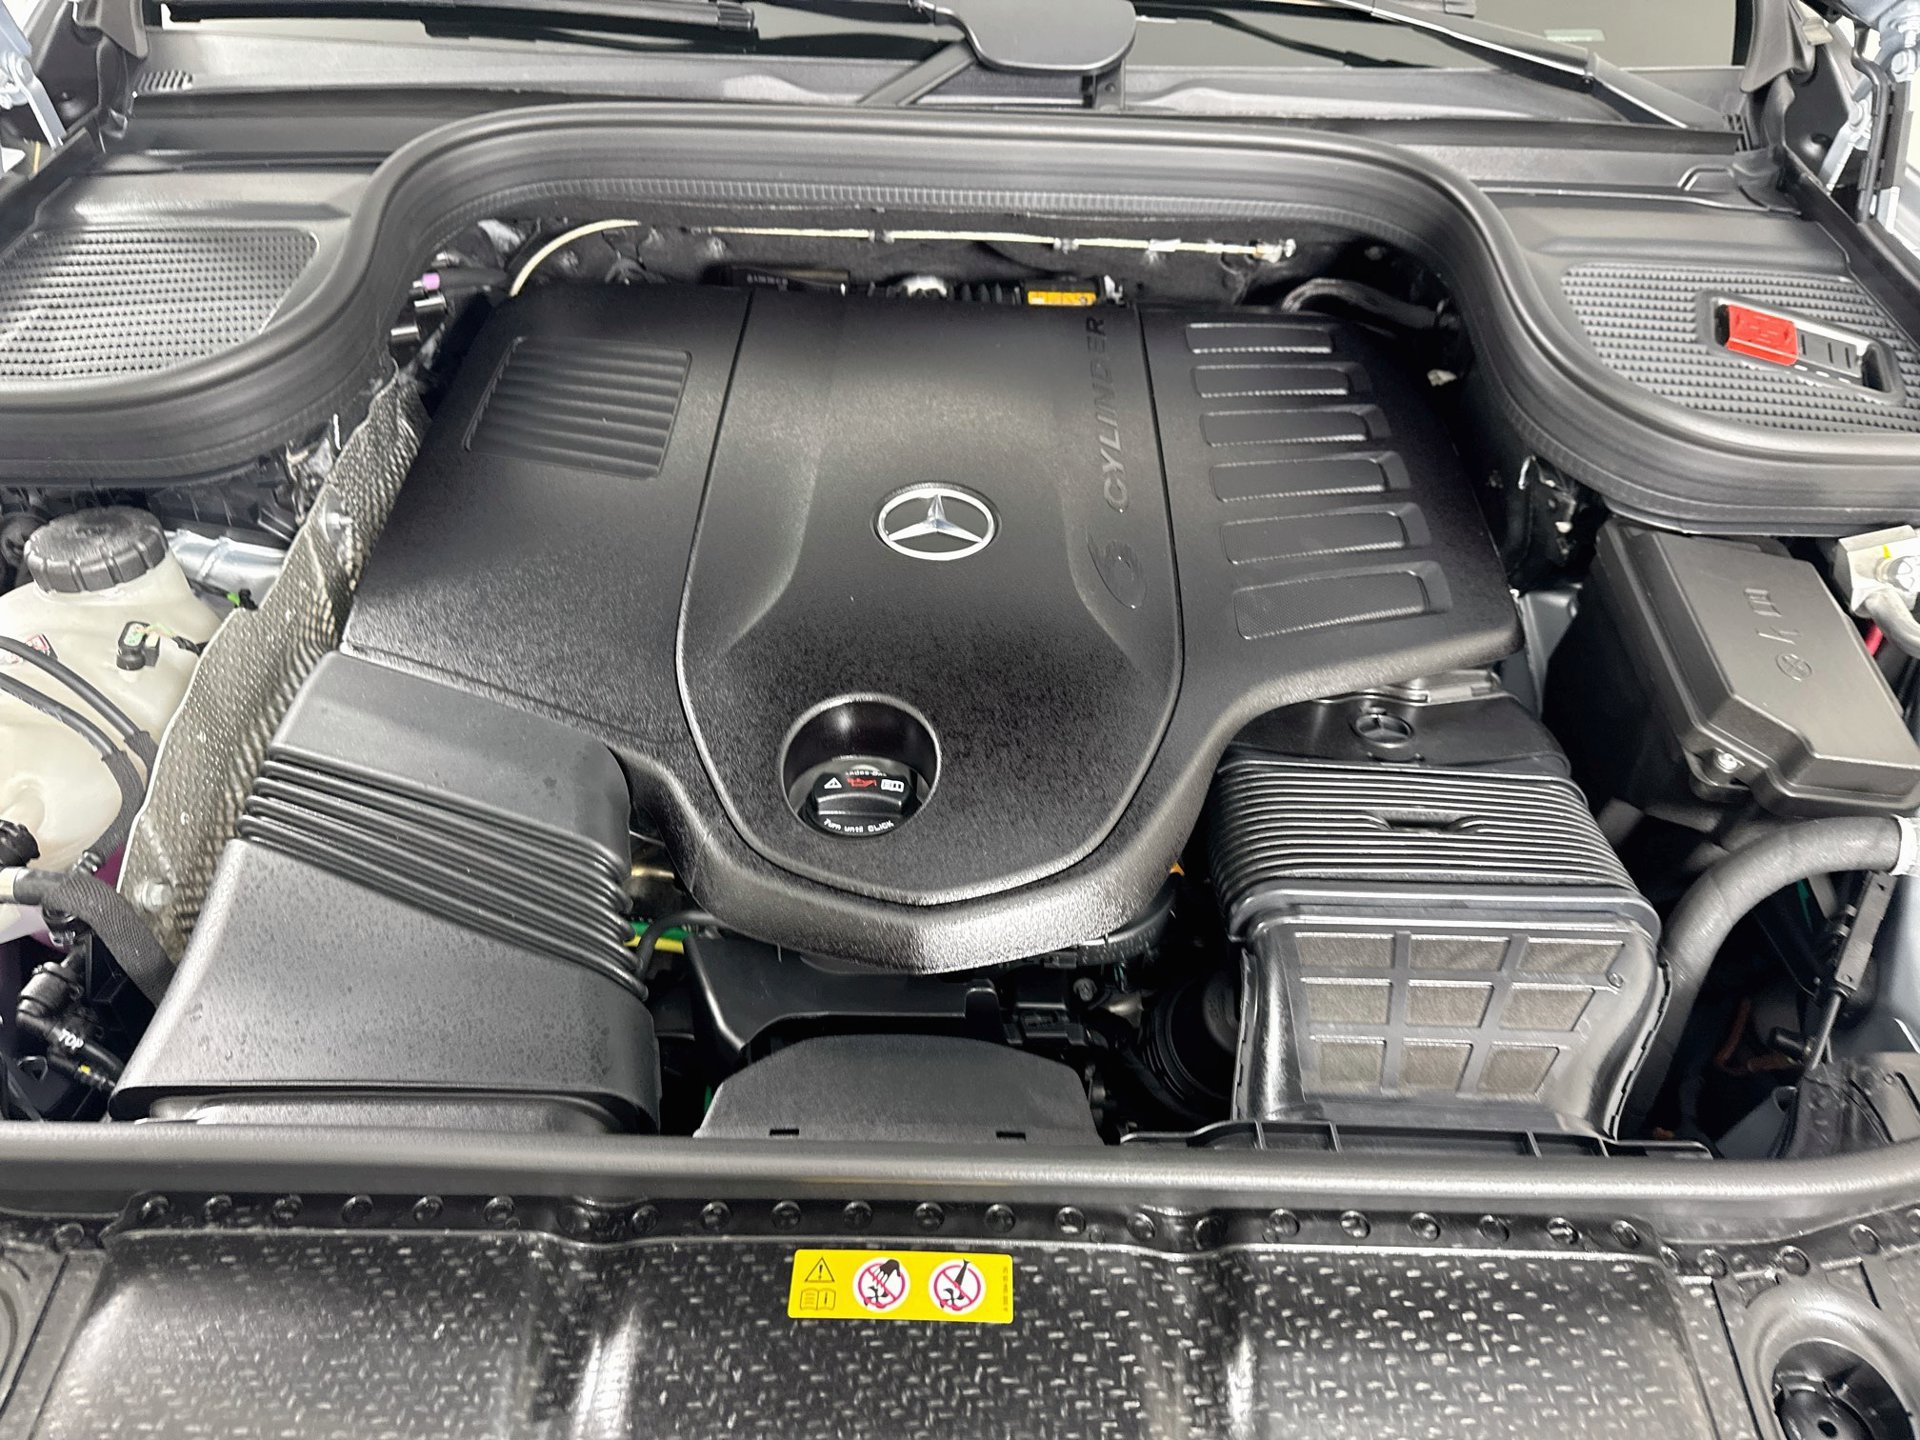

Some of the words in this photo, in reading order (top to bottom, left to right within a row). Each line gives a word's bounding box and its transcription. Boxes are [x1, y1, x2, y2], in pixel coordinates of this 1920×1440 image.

[1086, 315, 1128, 513] CYLINDER
[823, 818, 842, 831] Turn
[844, 825, 864, 833] until
[867, 820, 895, 832] CLICK
[52, 1027, 84, 1050] TOP
